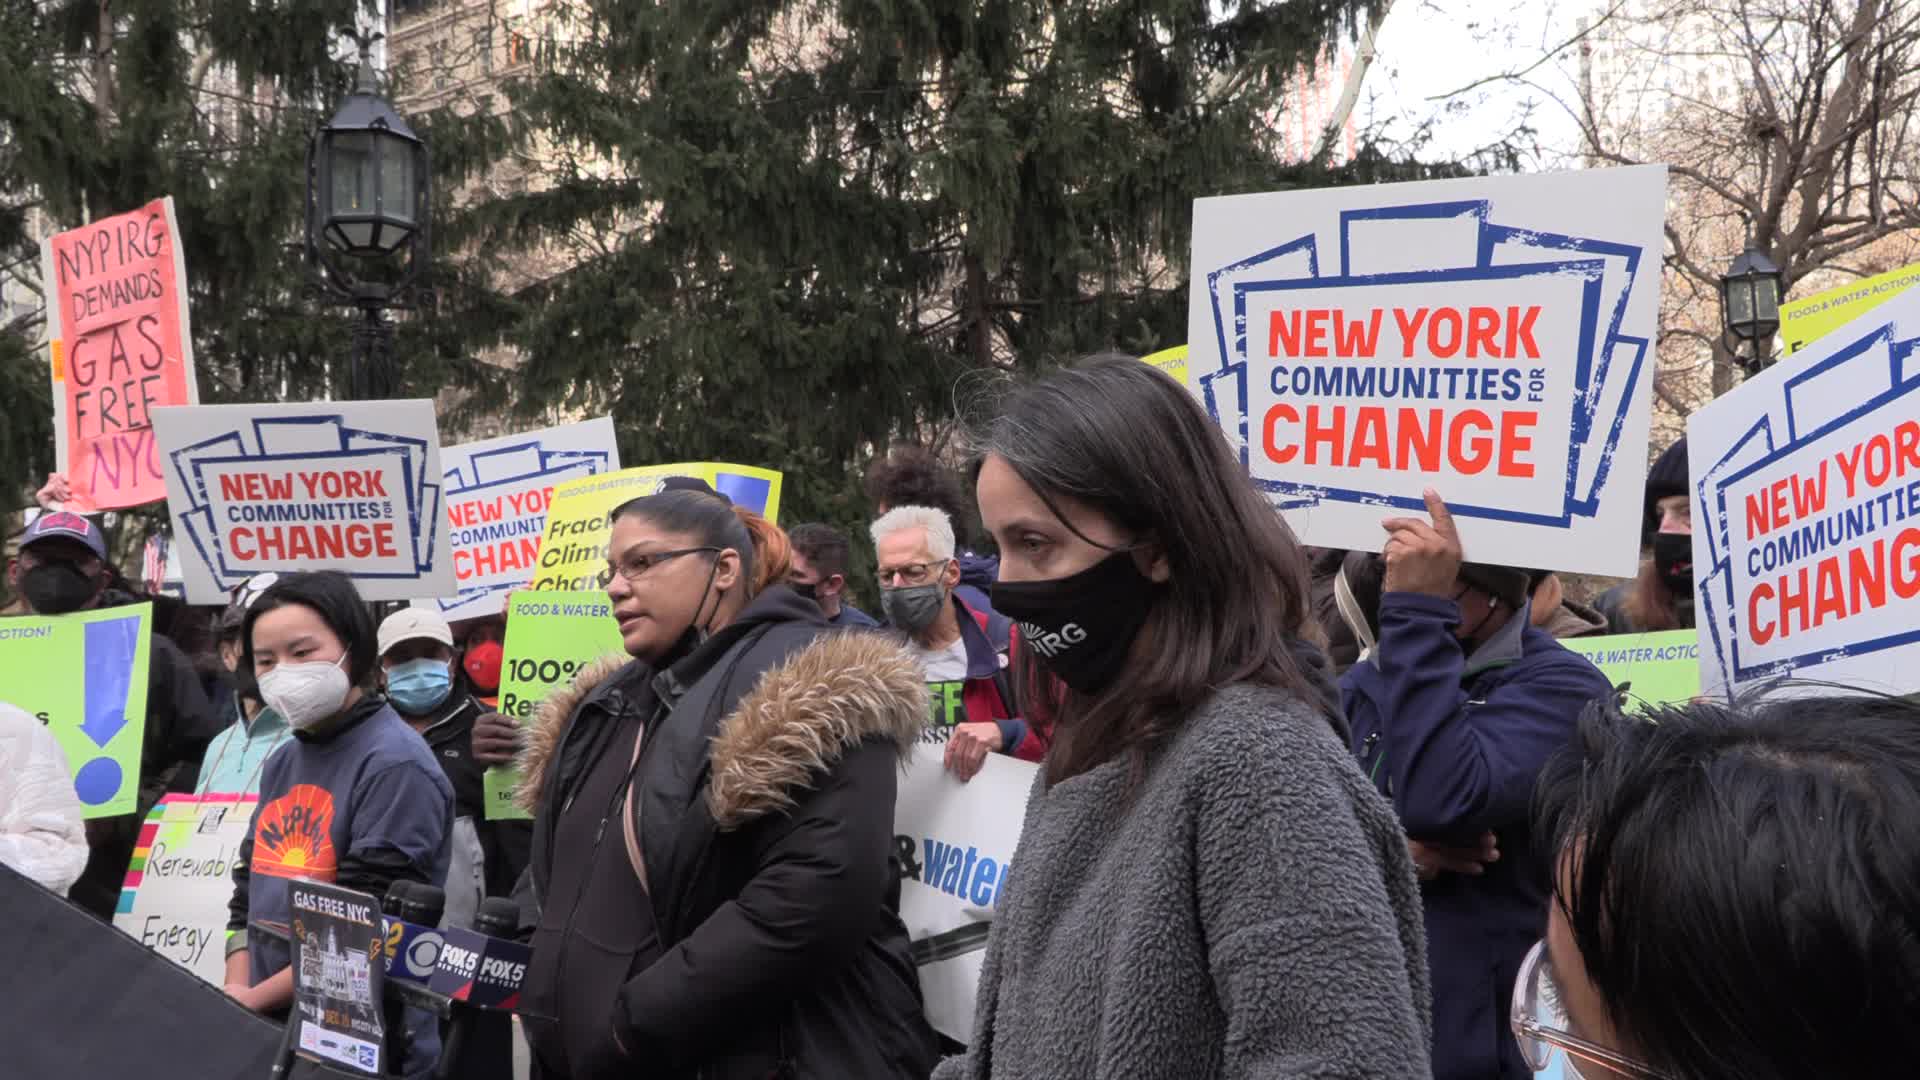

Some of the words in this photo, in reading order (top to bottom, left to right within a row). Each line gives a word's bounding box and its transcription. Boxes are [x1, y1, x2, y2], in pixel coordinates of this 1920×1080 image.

[58, 213, 163, 286] NYPIRG
[72, 268, 163, 321] DEMANDS
[1788, 304, 1820, 320] FOOD
[1830, 288, 1870, 308] WATER
[71, 315, 163, 387] GAS
[1268, 308, 1383, 358] NEW
[1392, 306, 1542, 359] YORK
[1270, 365, 1521, 402] COMMUNITIES
[1528, 368, 1545, 402] FOR
[76, 375, 160, 440] FREE
[1262, 403, 1538, 478] CHANGE
[219, 473, 293, 501] NEW
[298, 470, 387, 499] YORK
[1745, 458, 1828, 541] NEW
[1834, 420, 1920, 499] YOR
[228, 502, 381, 522] COMMUNITIES
[383, 501, 392, 518] FOR
[447, 496, 502, 528] NEW
[450, 516, 546, 547] COMMUNIT
[1747, 479, 1920, 577] COMMUNITIE
[229, 523, 397, 561] CHANGE
[453, 535, 542, 580] CHAN
[1748, 527, 1920, 646] CHANG
[516, 604, 549, 616] FOOD
[552, 604, 559, 615] &
[563, 604, 609, 617] WATER
[1028, 623, 1087, 658] IRG
[1607, 648, 1653, 664] WATER
[294, 891, 317, 911] GAS
[318, 896, 345, 918] FREE
[346, 903, 371, 923] NYC
[141, 916, 212, 966] Energy
